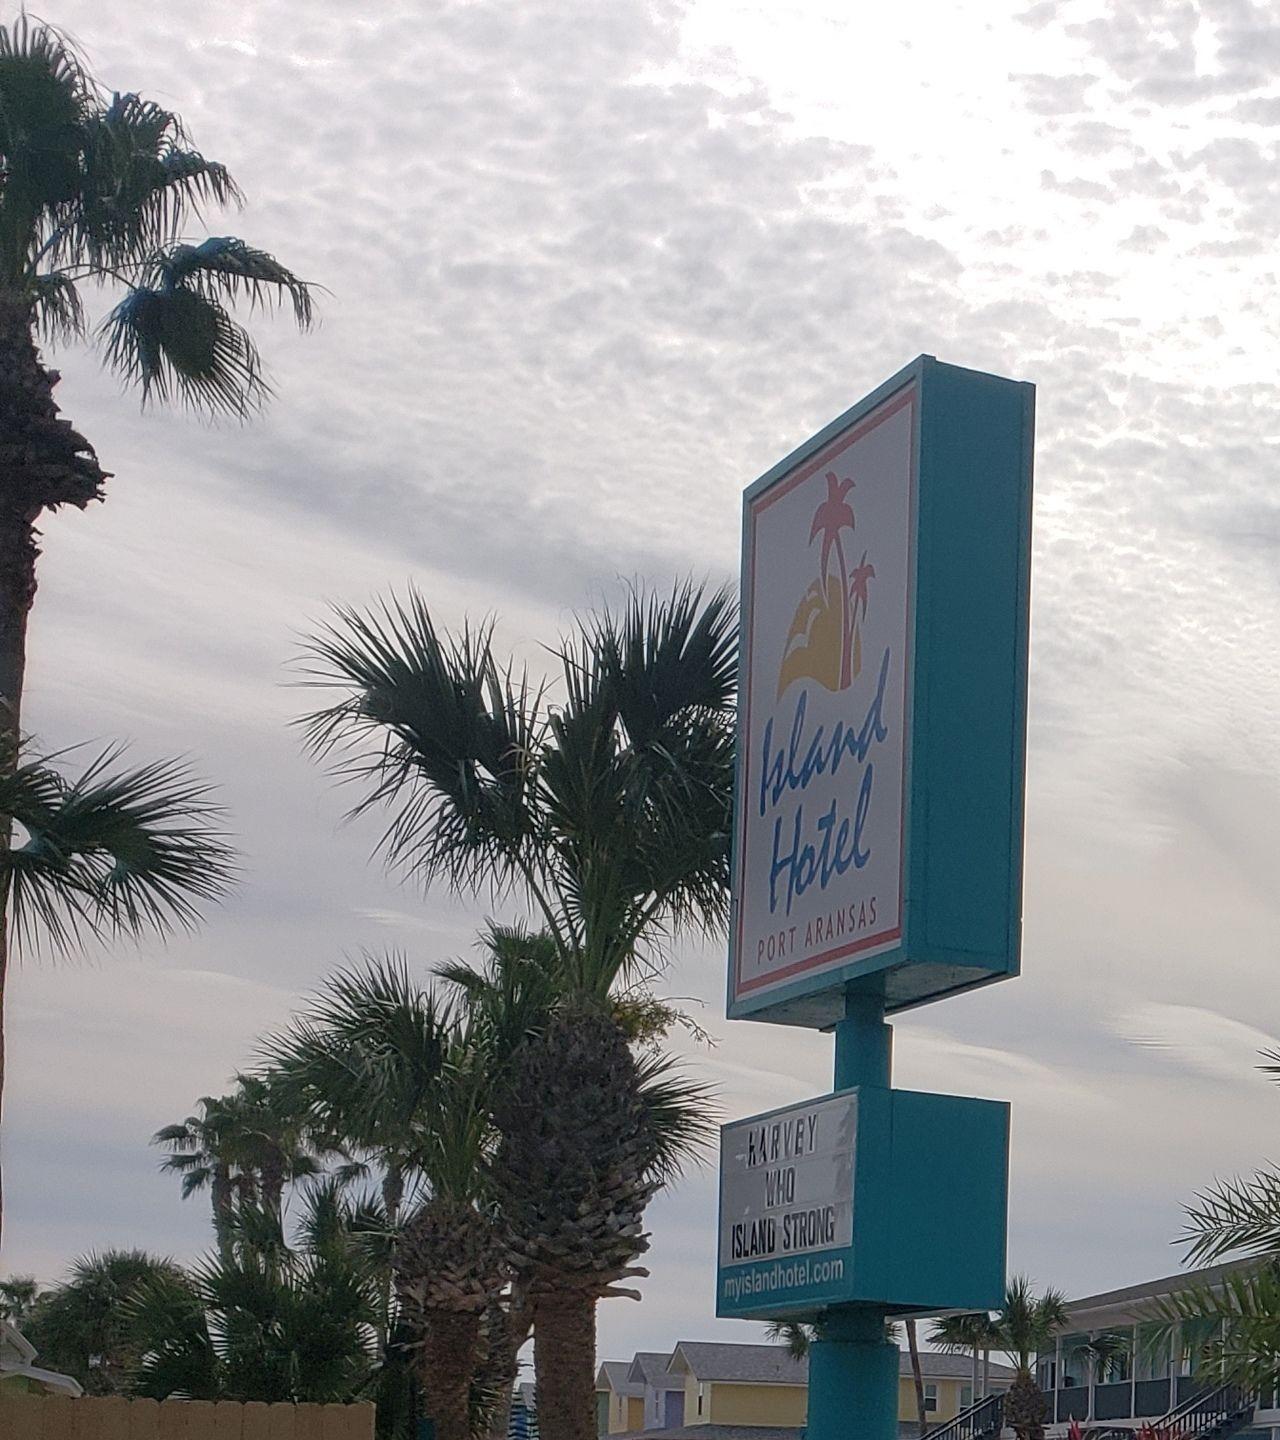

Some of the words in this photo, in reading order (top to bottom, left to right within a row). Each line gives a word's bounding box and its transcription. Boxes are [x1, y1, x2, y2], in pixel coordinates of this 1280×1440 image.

[760, 646, 889, 817] Island
[769, 763, 872, 917] Hotel
[757, 926, 797, 965] PORT
[804, 896, 877, 948] ARANSAS
[748, 1114, 817, 1167] HARVEY
[766, 1167, 796, 1207] WHO
[732, 1219, 776, 1259] ISLAND
[783, 1206, 835, 1250] STRONG
[724, 1259, 844, 1302] myislandhotel.com
